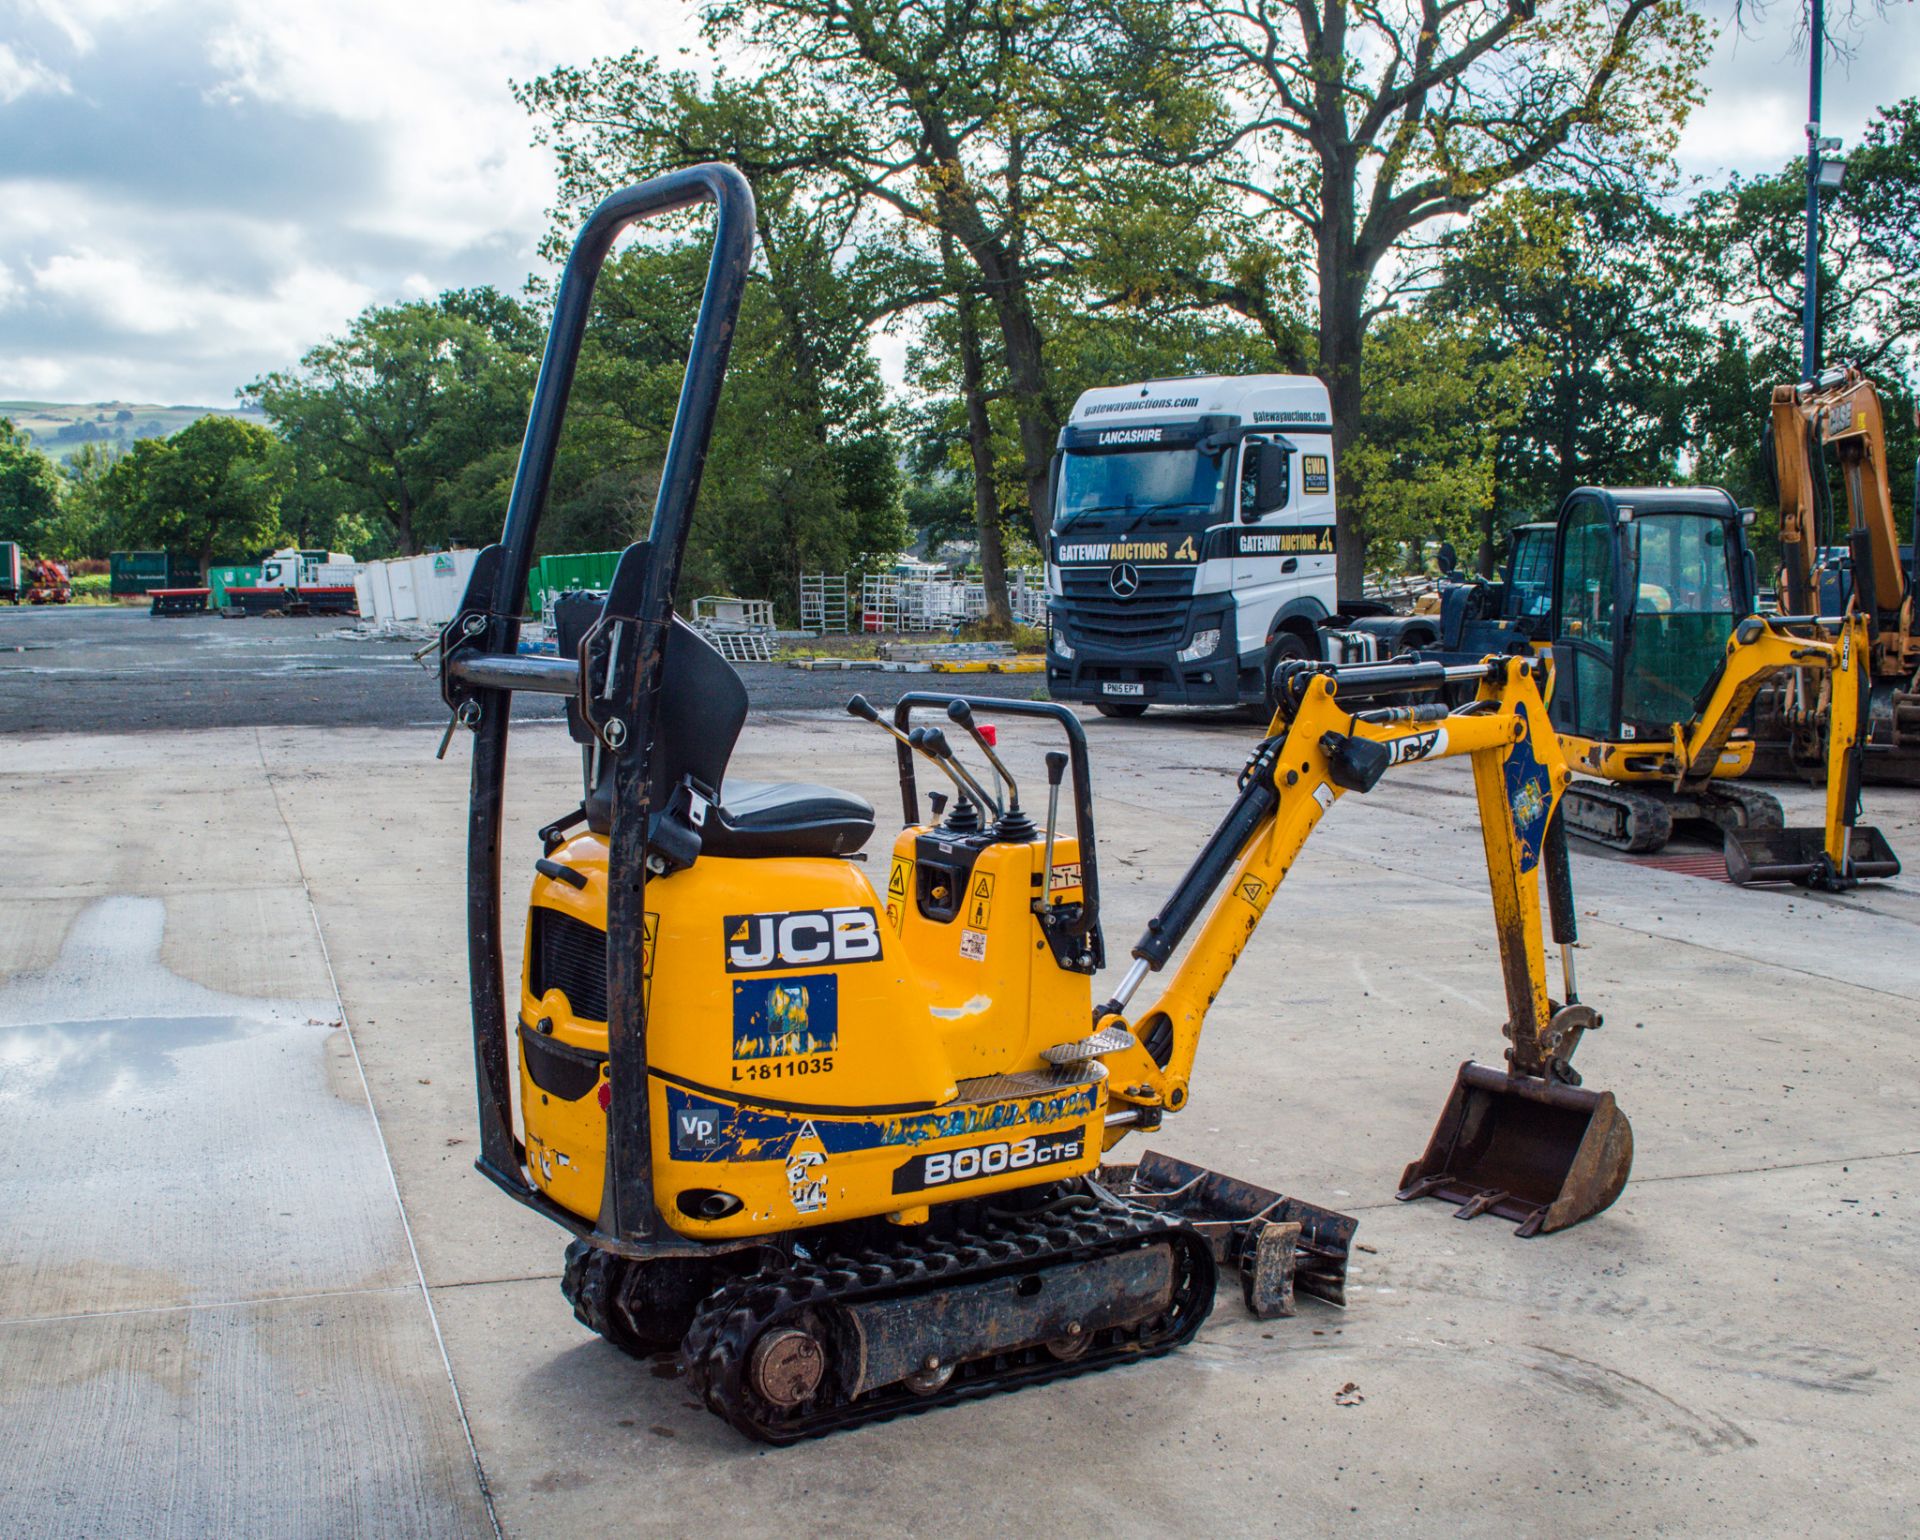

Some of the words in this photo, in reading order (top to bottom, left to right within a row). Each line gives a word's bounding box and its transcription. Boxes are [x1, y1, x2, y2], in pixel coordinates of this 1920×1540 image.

[1084, 397, 1199, 416] gatewayauctions.com
[1253, 411, 1327, 423] gatewayauctions.com
[1098, 429, 1162, 445] LANCASHIRE
[1305, 457, 1326, 475] GWA
[730, 911, 880, 967] JCB
[732, 1057, 834, 1081] L1811035
[681, 1117, 713, 1141] Vp
[704, 1138, 717, 1147] plc
